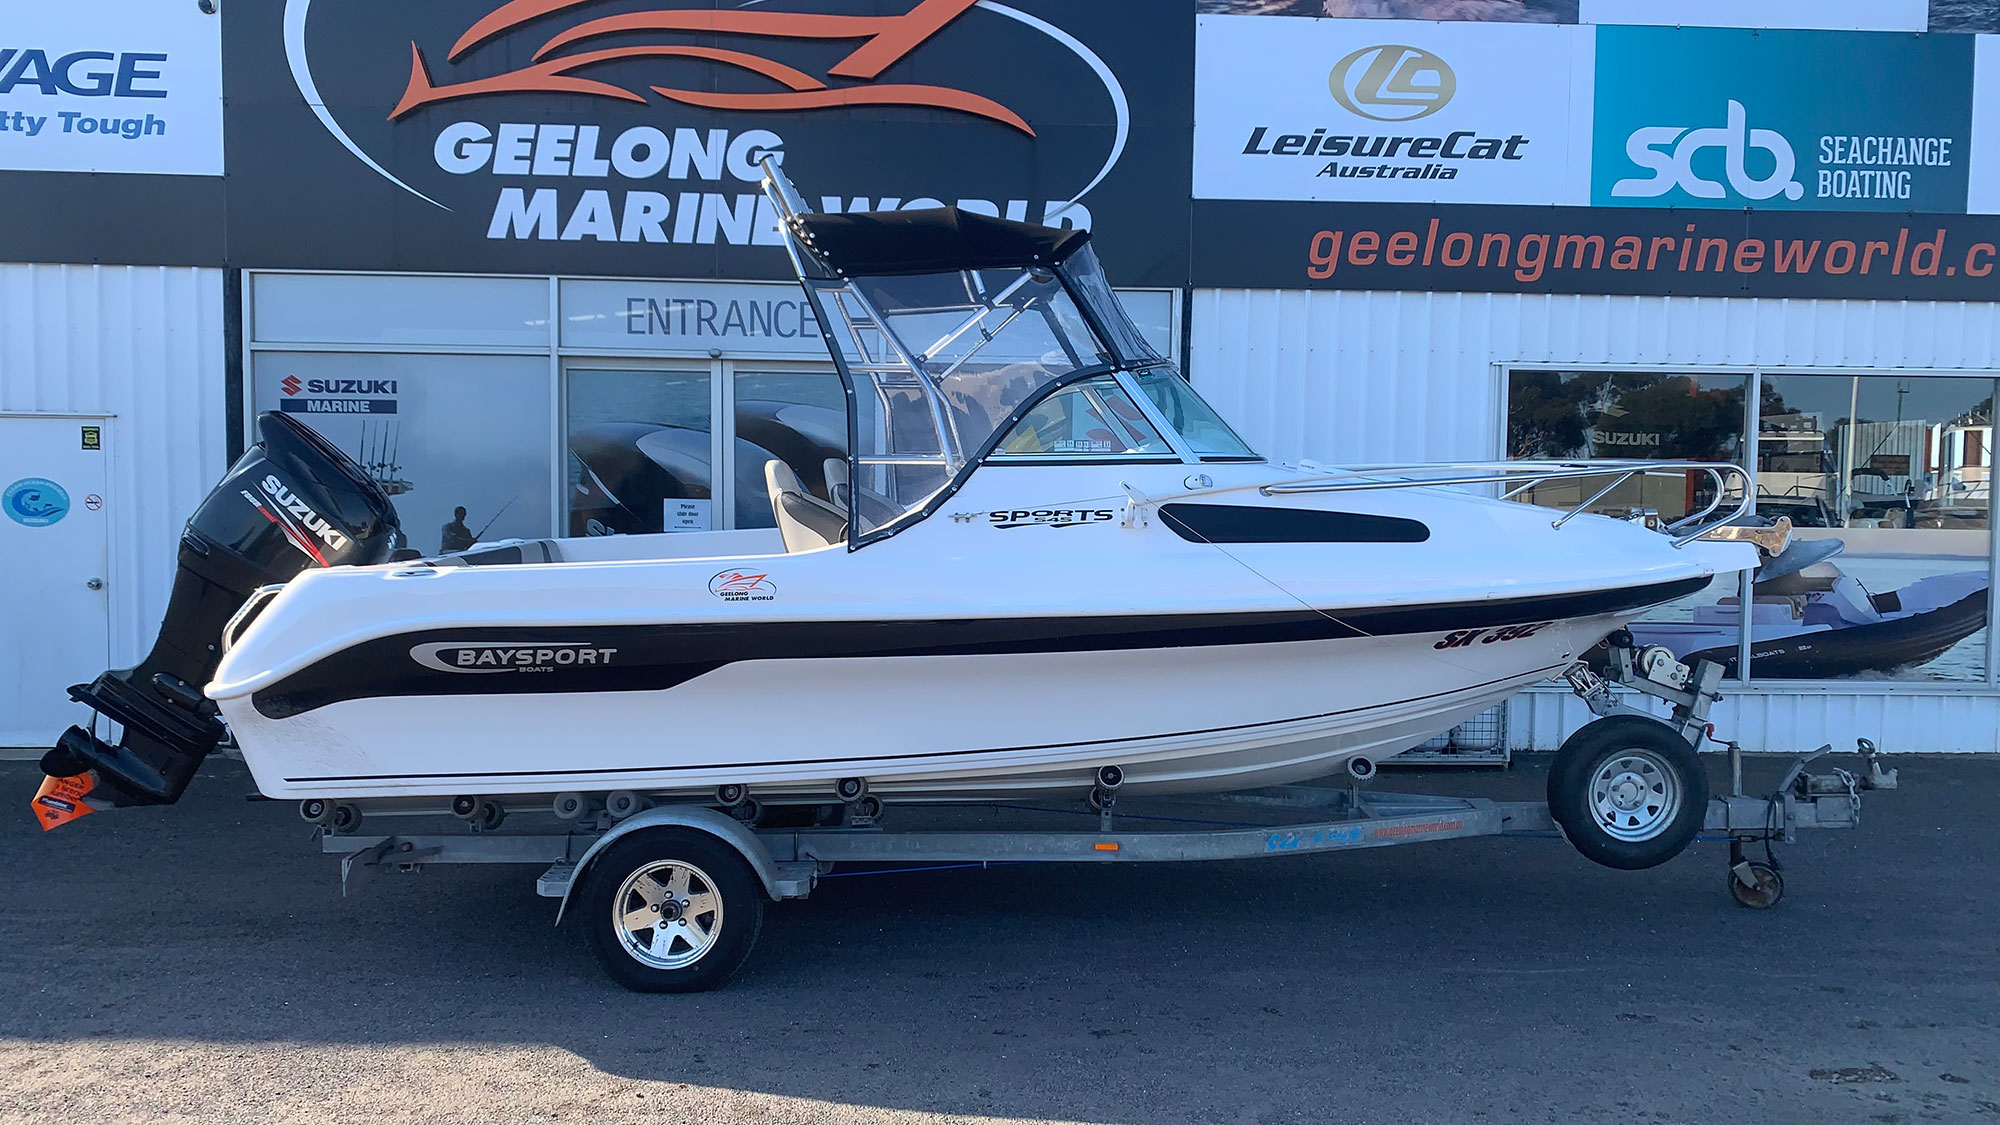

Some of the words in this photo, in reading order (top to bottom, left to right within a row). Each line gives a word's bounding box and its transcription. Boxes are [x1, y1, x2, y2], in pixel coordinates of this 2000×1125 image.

[58, 112, 166, 139] Tough
[434, 122, 785, 182] GEELONG
[1241, 127, 1530, 160] LeisureCat
[1818, 136, 1952, 166] SEACHANGE
[1315, 162, 1458, 180] Australia
[1817, 169, 1911, 199] BOATING
[626, 298, 818, 338] ENTRANCE
[307, 379, 397, 394] SUZUKI
[307, 400, 370, 413] MARINE
[1592, 430, 1660, 446] SUZUKI
[261, 474, 348, 552] SUZUKI
[989, 509, 1114, 523] SPORTS
[457, 648, 618, 666] BAYSPORT
[518, 666, 555, 674] BOATS
